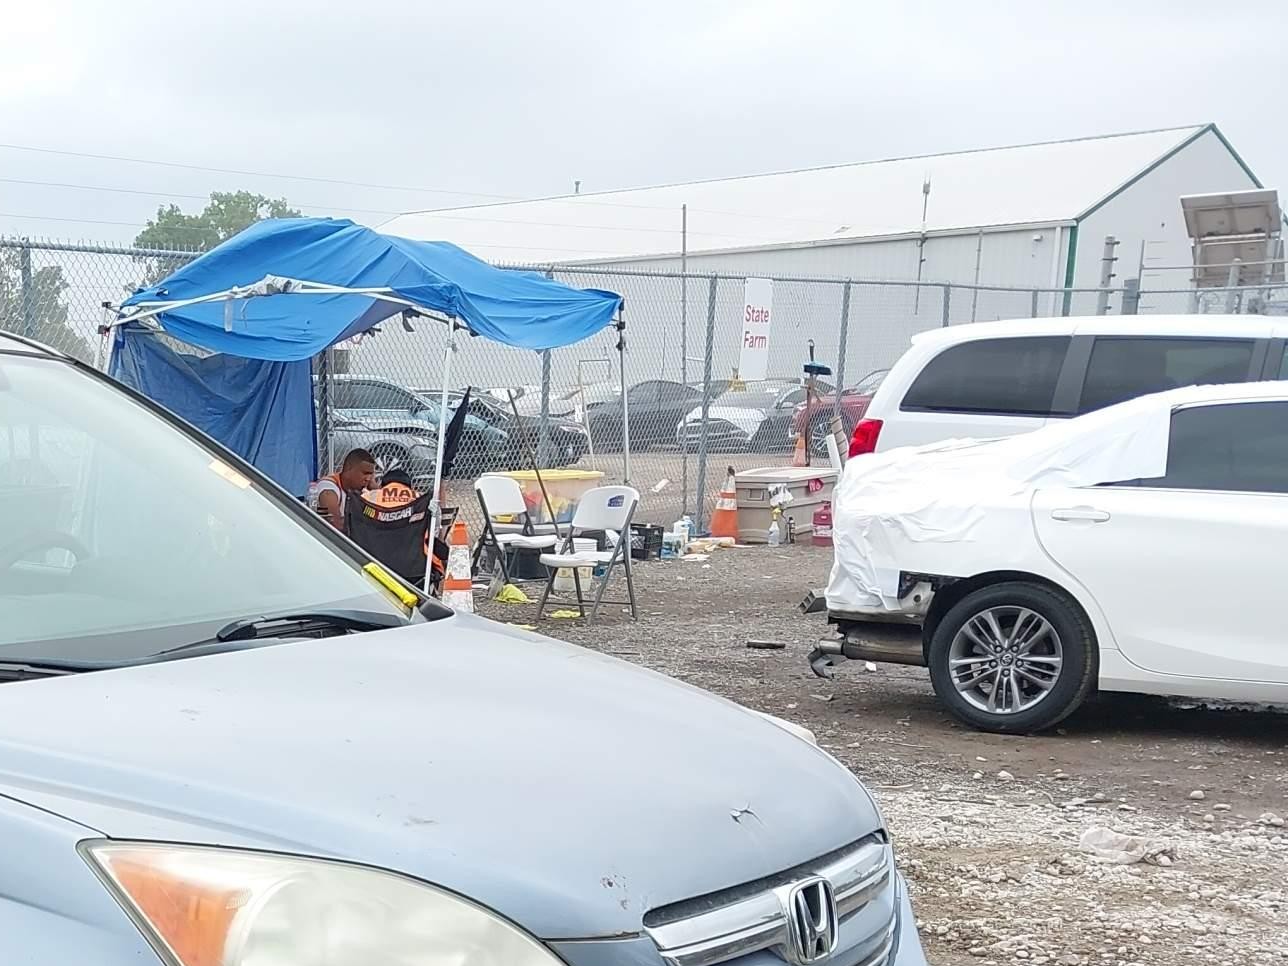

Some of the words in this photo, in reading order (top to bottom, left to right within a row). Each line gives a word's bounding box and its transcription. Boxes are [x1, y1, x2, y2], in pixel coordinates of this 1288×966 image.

[745, 304, 770, 323] State
[744, 330, 767, 349] Farm
[377, 507, 411, 521] NASCAR
